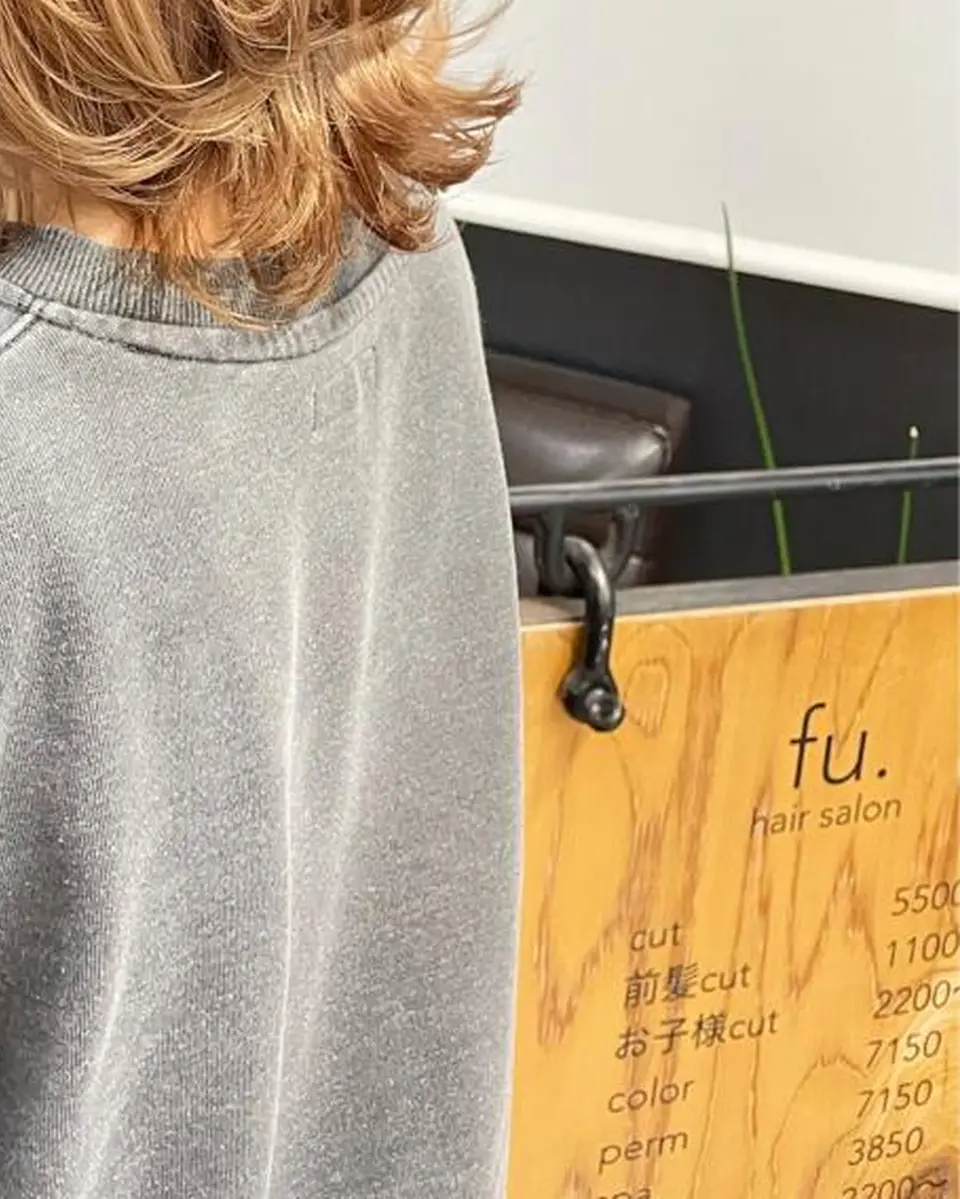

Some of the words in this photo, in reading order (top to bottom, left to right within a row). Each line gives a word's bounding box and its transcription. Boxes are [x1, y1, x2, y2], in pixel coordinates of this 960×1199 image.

[789, 702, 887, 789] fu.
[750, 803, 810, 839] hair
[819, 792, 901, 828] salon
[630, 921, 681, 952] cut
[624, 962, 751, 1010] 前髪cut
[873, 979, 960, 1020] 2200
[614, 1011, 778, 1059] お子様cut
[866, 1030, 942, 1069] 7150
[607, 1076, 695, 1114] color
[857, 1079, 933, 1119] 7150
[597, 1131, 689, 1176] perm
[847, 1126, 924, 1166] 3850
